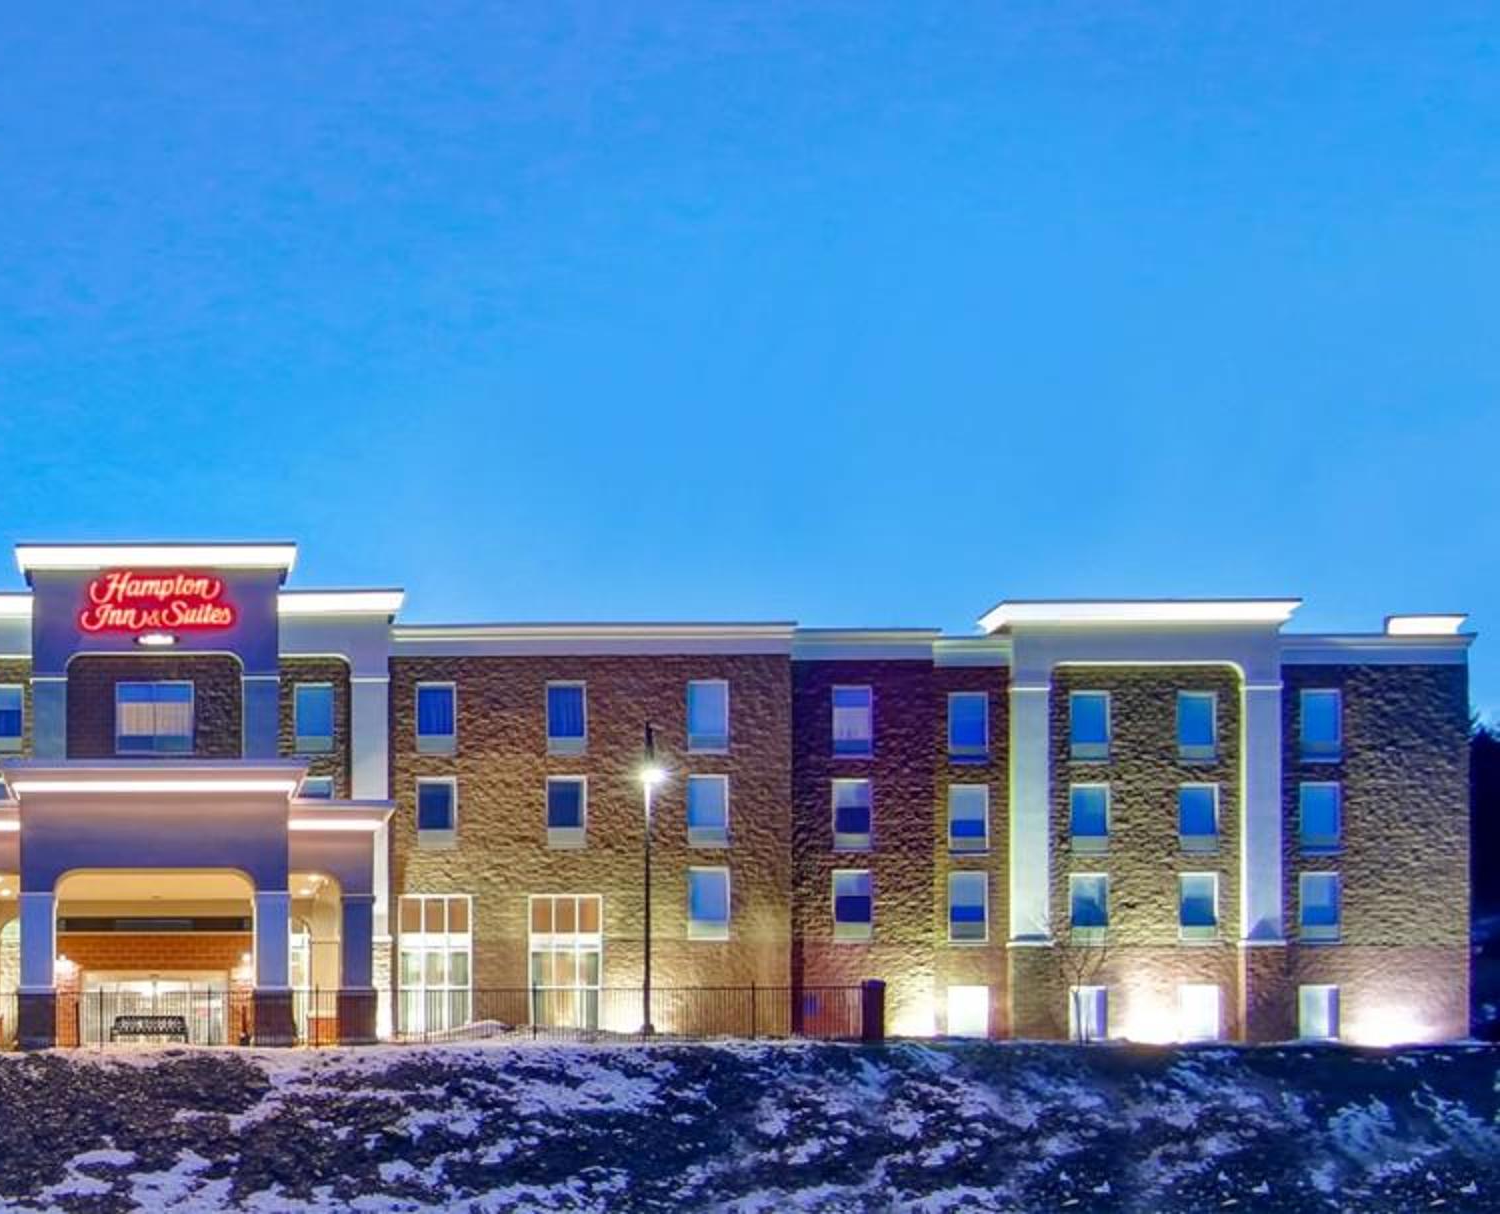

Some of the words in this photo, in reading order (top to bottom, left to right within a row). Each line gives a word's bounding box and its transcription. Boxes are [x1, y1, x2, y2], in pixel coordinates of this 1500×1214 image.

[90, 571, 221, 604] Hampton
[81, 603, 148, 630] Inn
[149, 609, 162, 626] &
[162, 600, 232, 626] Suites
